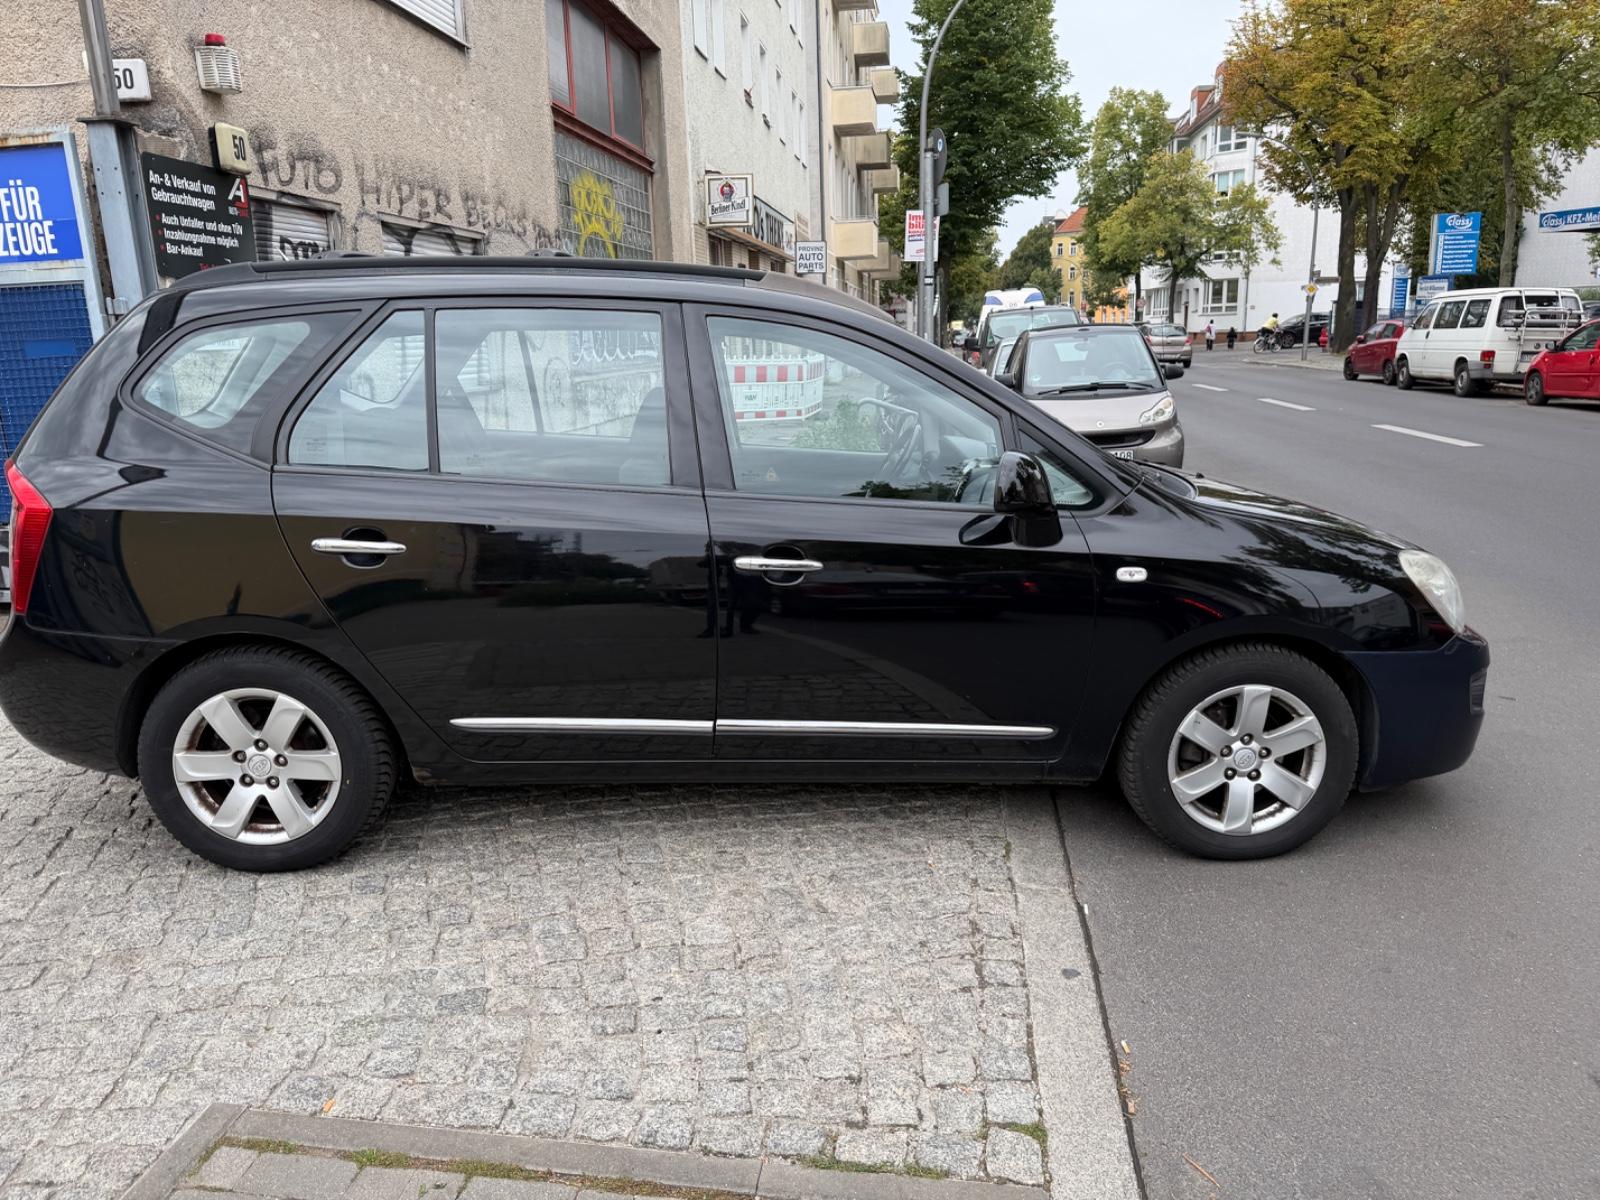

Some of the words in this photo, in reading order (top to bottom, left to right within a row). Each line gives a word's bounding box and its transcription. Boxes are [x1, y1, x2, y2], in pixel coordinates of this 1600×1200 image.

[232, 135, 246, 160] 50
[149, 170, 163, 184] An-
[164, 173, 171, 187] &
[171, 175, 201, 192] Verkauf
[202, 184, 216, 195] von
[0, 179, 43, 221] FÜR
[151, 187, 216, 211] Gebrauchtwagen
[711, 203, 731, 215] Berliner
[161, 213, 179, 226] Auch
[205, 221, 217, 231] und
[218, 222, 232, 233] ohne
[166, 243, 203, 256] Bar-Ankauf
[798, 262, 824, 270] PARTS
